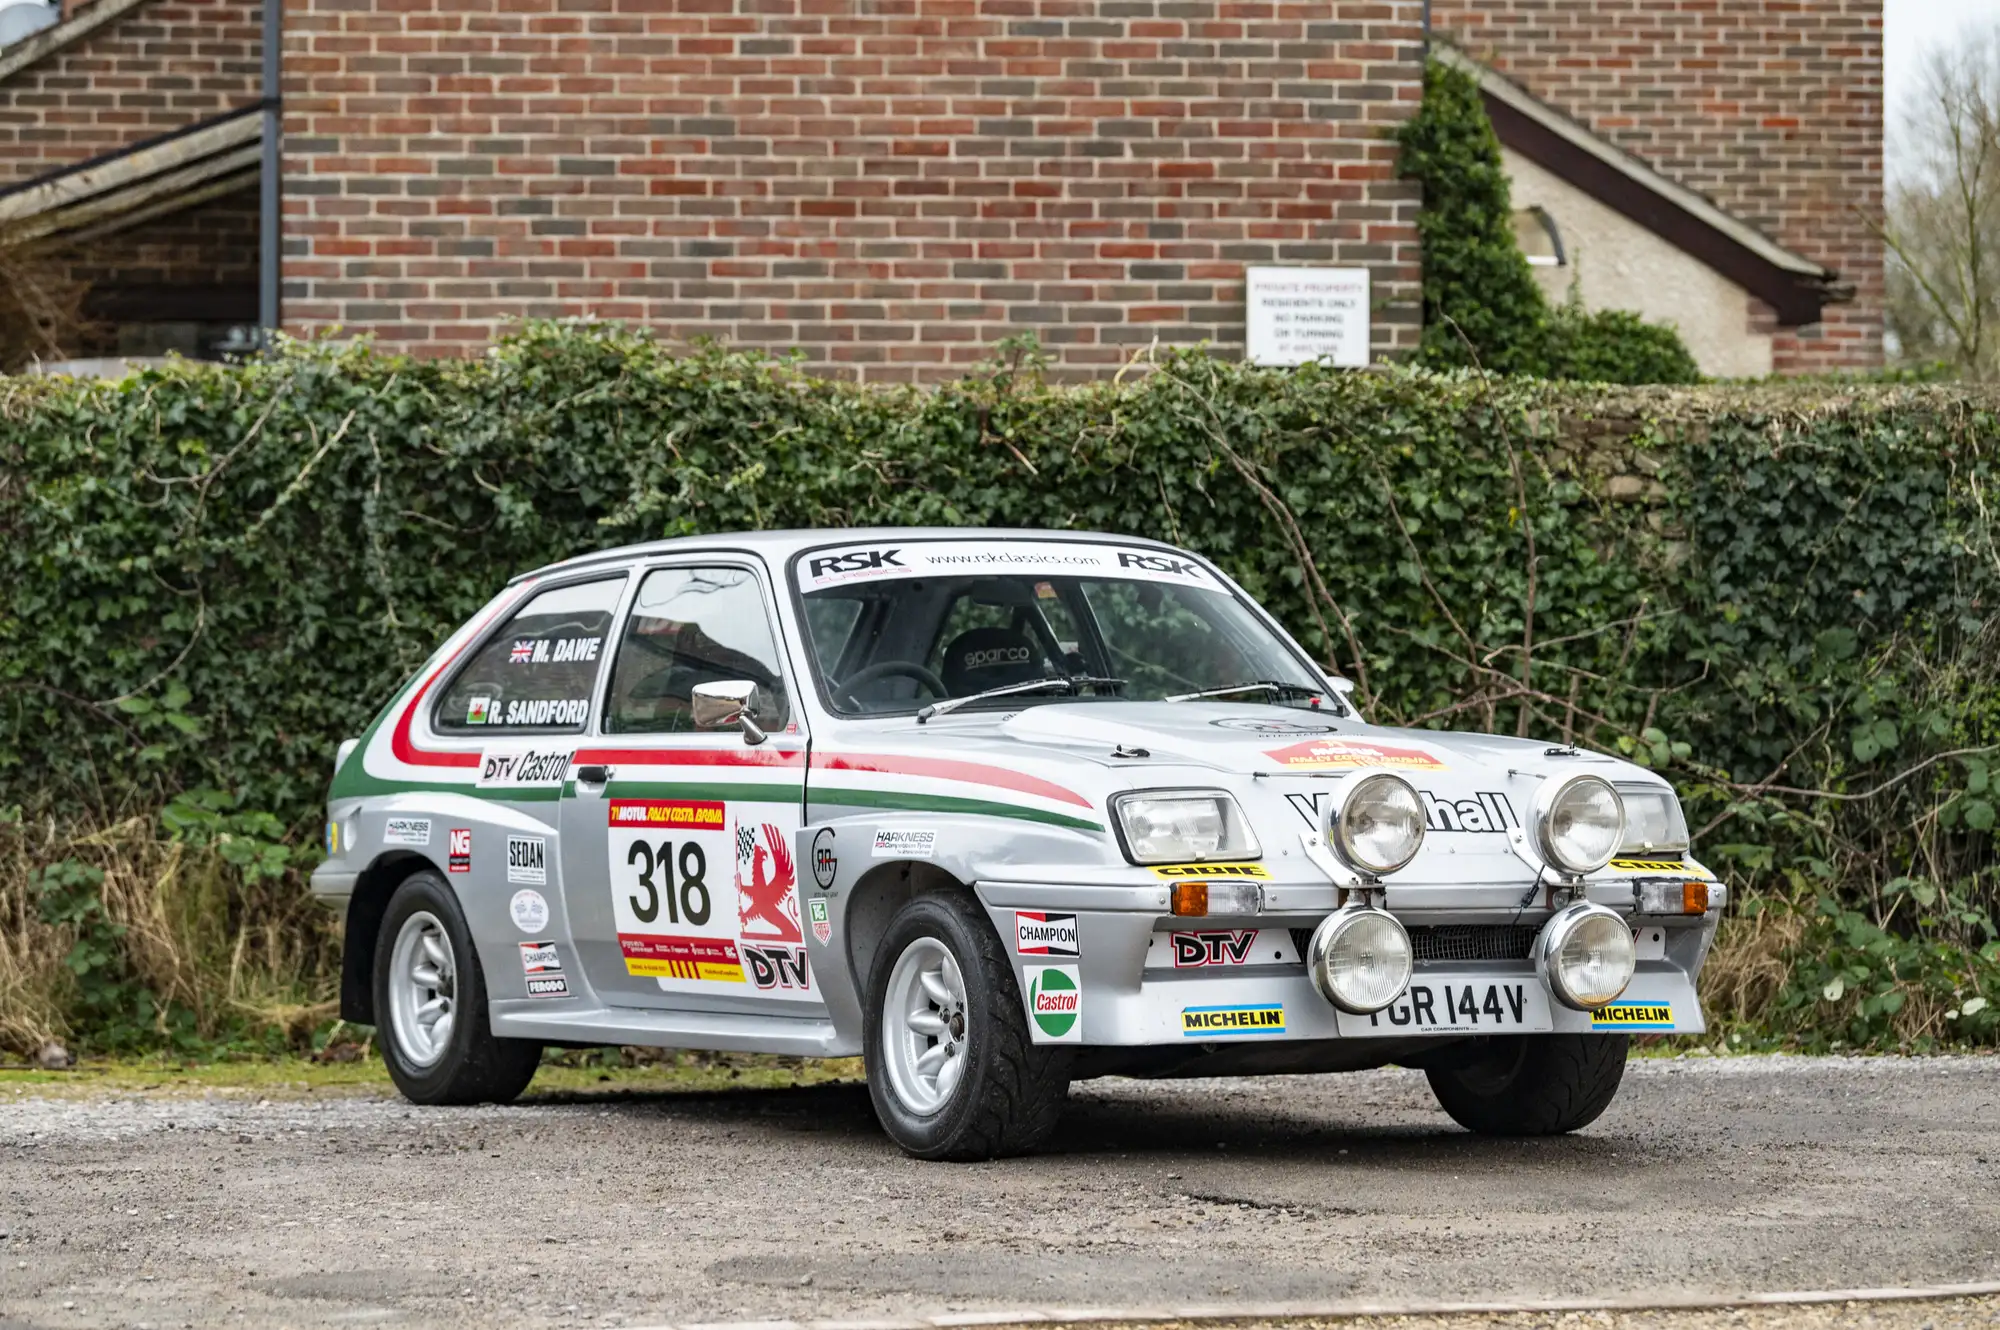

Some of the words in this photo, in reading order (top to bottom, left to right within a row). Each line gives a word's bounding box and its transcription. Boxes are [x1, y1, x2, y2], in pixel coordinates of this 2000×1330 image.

[1294, 313, 1344, 325] PARKING
[809, 549, 905, 578] RSK
[925, 552, 1101, 566] www.rskclassics.com
[1117, 552, 1203, 580] RSK
[532, 639, 550, 663] M.
[552, 637, 601, 662] DAWE
[964, 646, 1029, 667] sparco
[488, 700, 504, 724] R.
[506, 699, 590, 724] SANDFORD
[484, 756, 519, 780] DTV
[517, 750, 575, 782] Castrol
[619, 806, 647, 821] MOTUL
[647, 807, 671, 821] RALLY
[671, 807, 694, 822] COSTA
[695, 808, 723, 824] BRAVA
[1284, 791, 1520, 833] Vhall
[450, 830, 470, 855] NG
[876, 832, 935, 842] HARKNESS
[510, 841, 544, 868] SEDAN
[628, 839, 711, 926] 318
[1157, 866, 1266, 876] CIBIE
[1020, 926, 1075, 942] CHAMPION
[525, 951, 557, 963] CHAMPION
[1172, 931, 1257, 966] DTV
[742, 946, 808, 987] DTV
[529, 980, 564, 993] FERODO
[1037, 994, 1078, 1010] Castrol
[1445, 985, 1523, 1024] 144V
[1184, 1011, 1281, 1027] MICHELIN
[1593, 1008, 1670, 1021] MICHELIN
